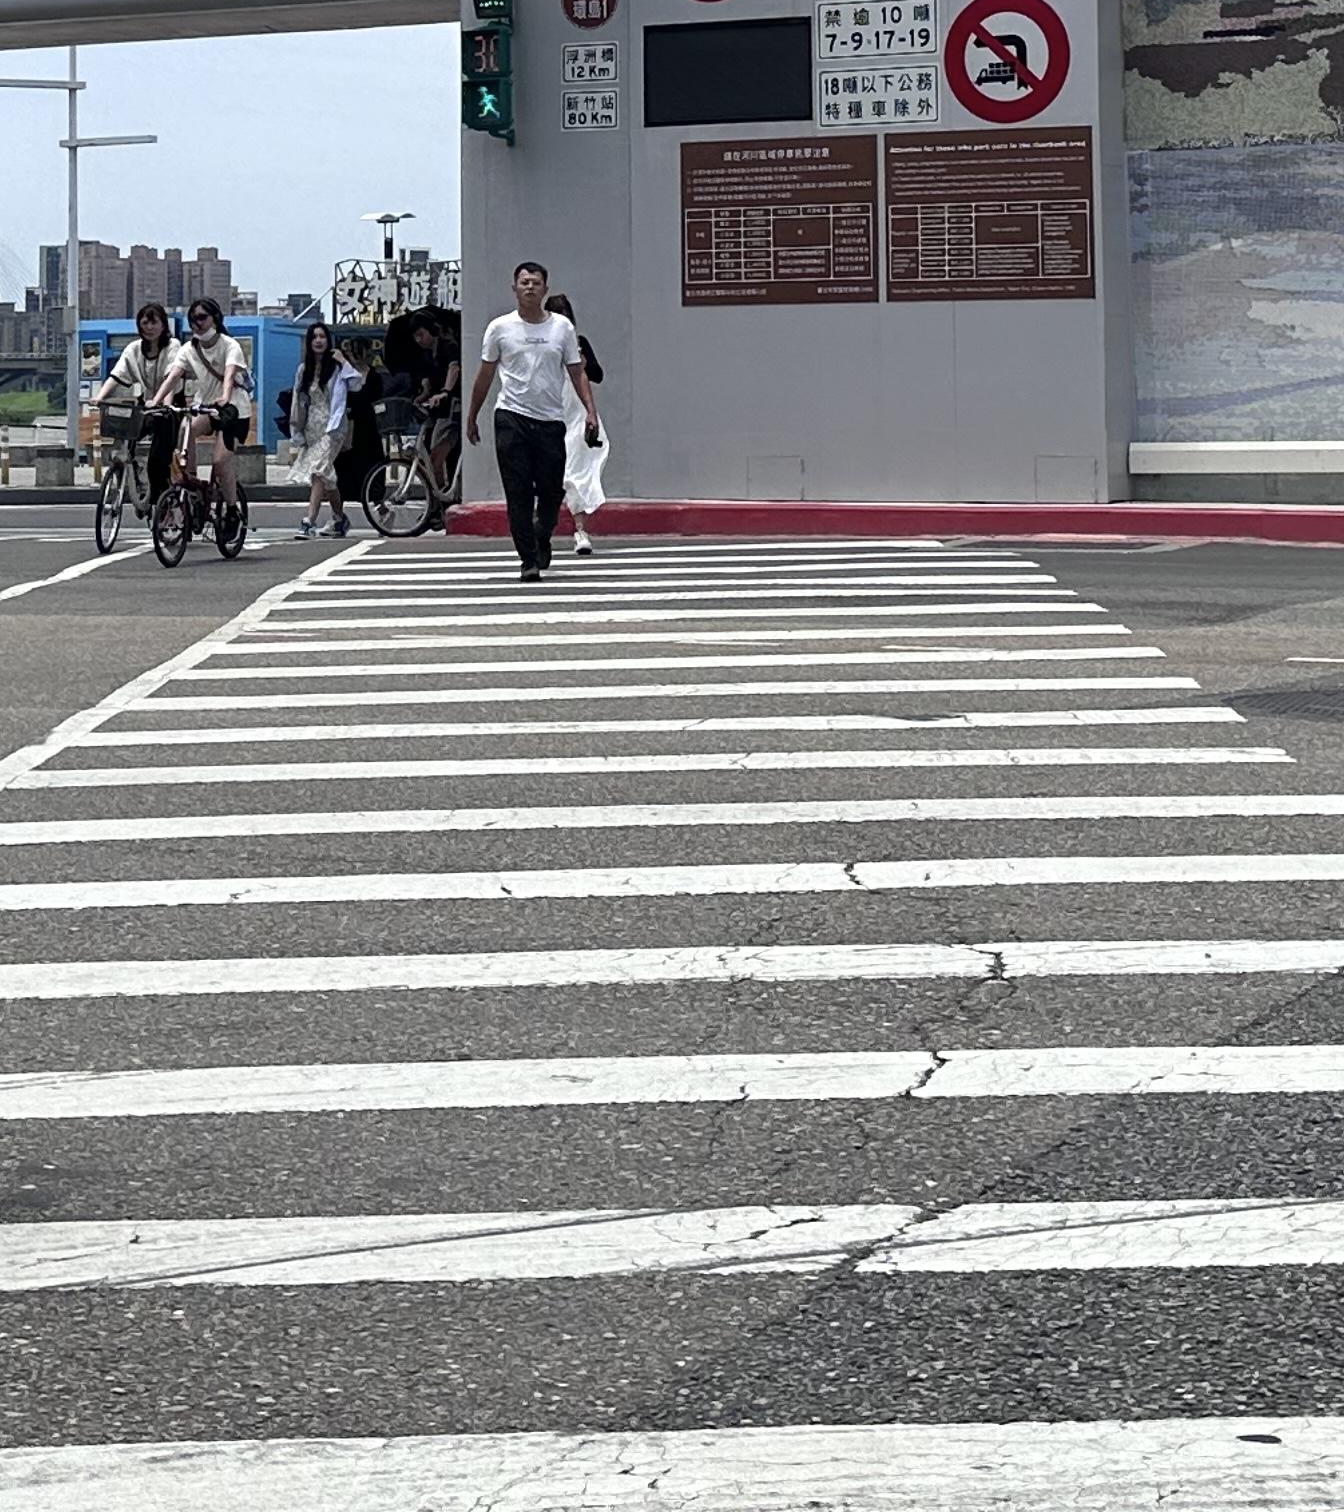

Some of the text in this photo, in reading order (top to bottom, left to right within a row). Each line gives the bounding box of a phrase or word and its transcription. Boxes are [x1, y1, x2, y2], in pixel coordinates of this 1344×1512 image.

[571, 64, 610, 79] 12 Km
[565, 95, 614, 112] 新竹站
[568, 111, 613, 125] 80 Km
